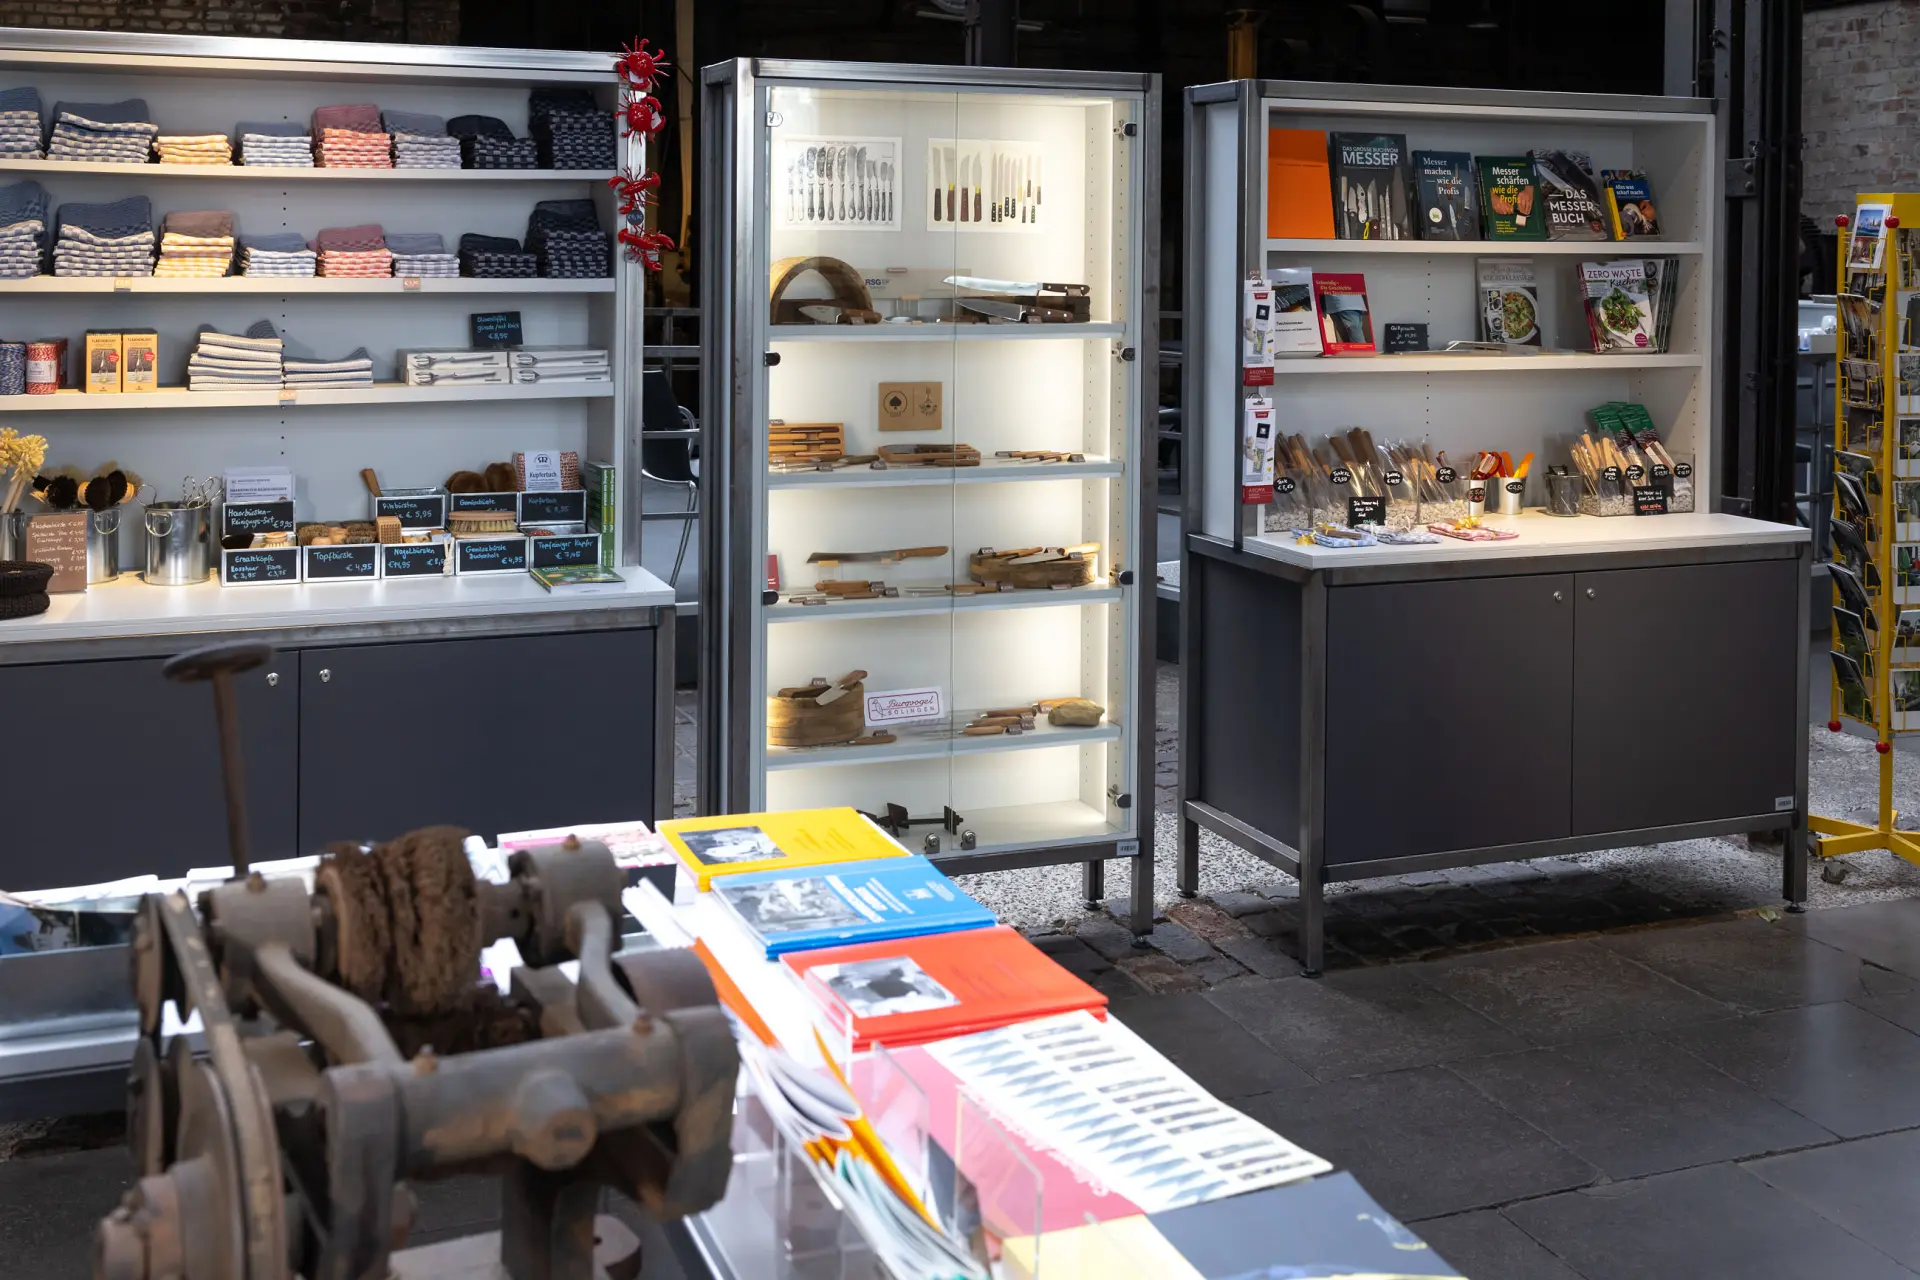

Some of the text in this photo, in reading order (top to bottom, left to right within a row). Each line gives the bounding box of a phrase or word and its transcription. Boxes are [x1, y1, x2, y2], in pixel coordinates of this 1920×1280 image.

[1342, 151, 1399, 166] MESSER
[1423, 157, 1447, 166] Messer
[1424, 167, 1452, 175] machen
[1492, 167, 1519, 175] Messer
[1436, 177, 1462, 185] wie die
[1496, 176, 1529, 185] schärfen
[1438, 187, 1460, 195] Profis
[1492, 185, 1519, 195] wie die
[1565, 189, 1587, 199] DAS
[1549, 200, 1595, 212] MESSER
[1552, 213, 1585, 224] BUCH
[1587, 269, 1642, 280] ZERO WASTE
[865, 278, 882, 286] RSG
[1610, 278, 1640, 288] Kitchen
[415, 510, 432, 519] 5,95
[280, 520, 292, 529] 9,95
[574, 539, 594, 548] Kupfer
[394, 548, 435, 560] Nagelbürsten
[465, 545, 507, 554] Gemüsebürste
[313, 551, 354, 561] Topfbürste
[508, 556, 523, 564] 4,95
[355, 562, 373, 572] 4,95
[887, 695, 934, 709] Burgvogel
[887, 706, 935, 716] SOLINGEN
